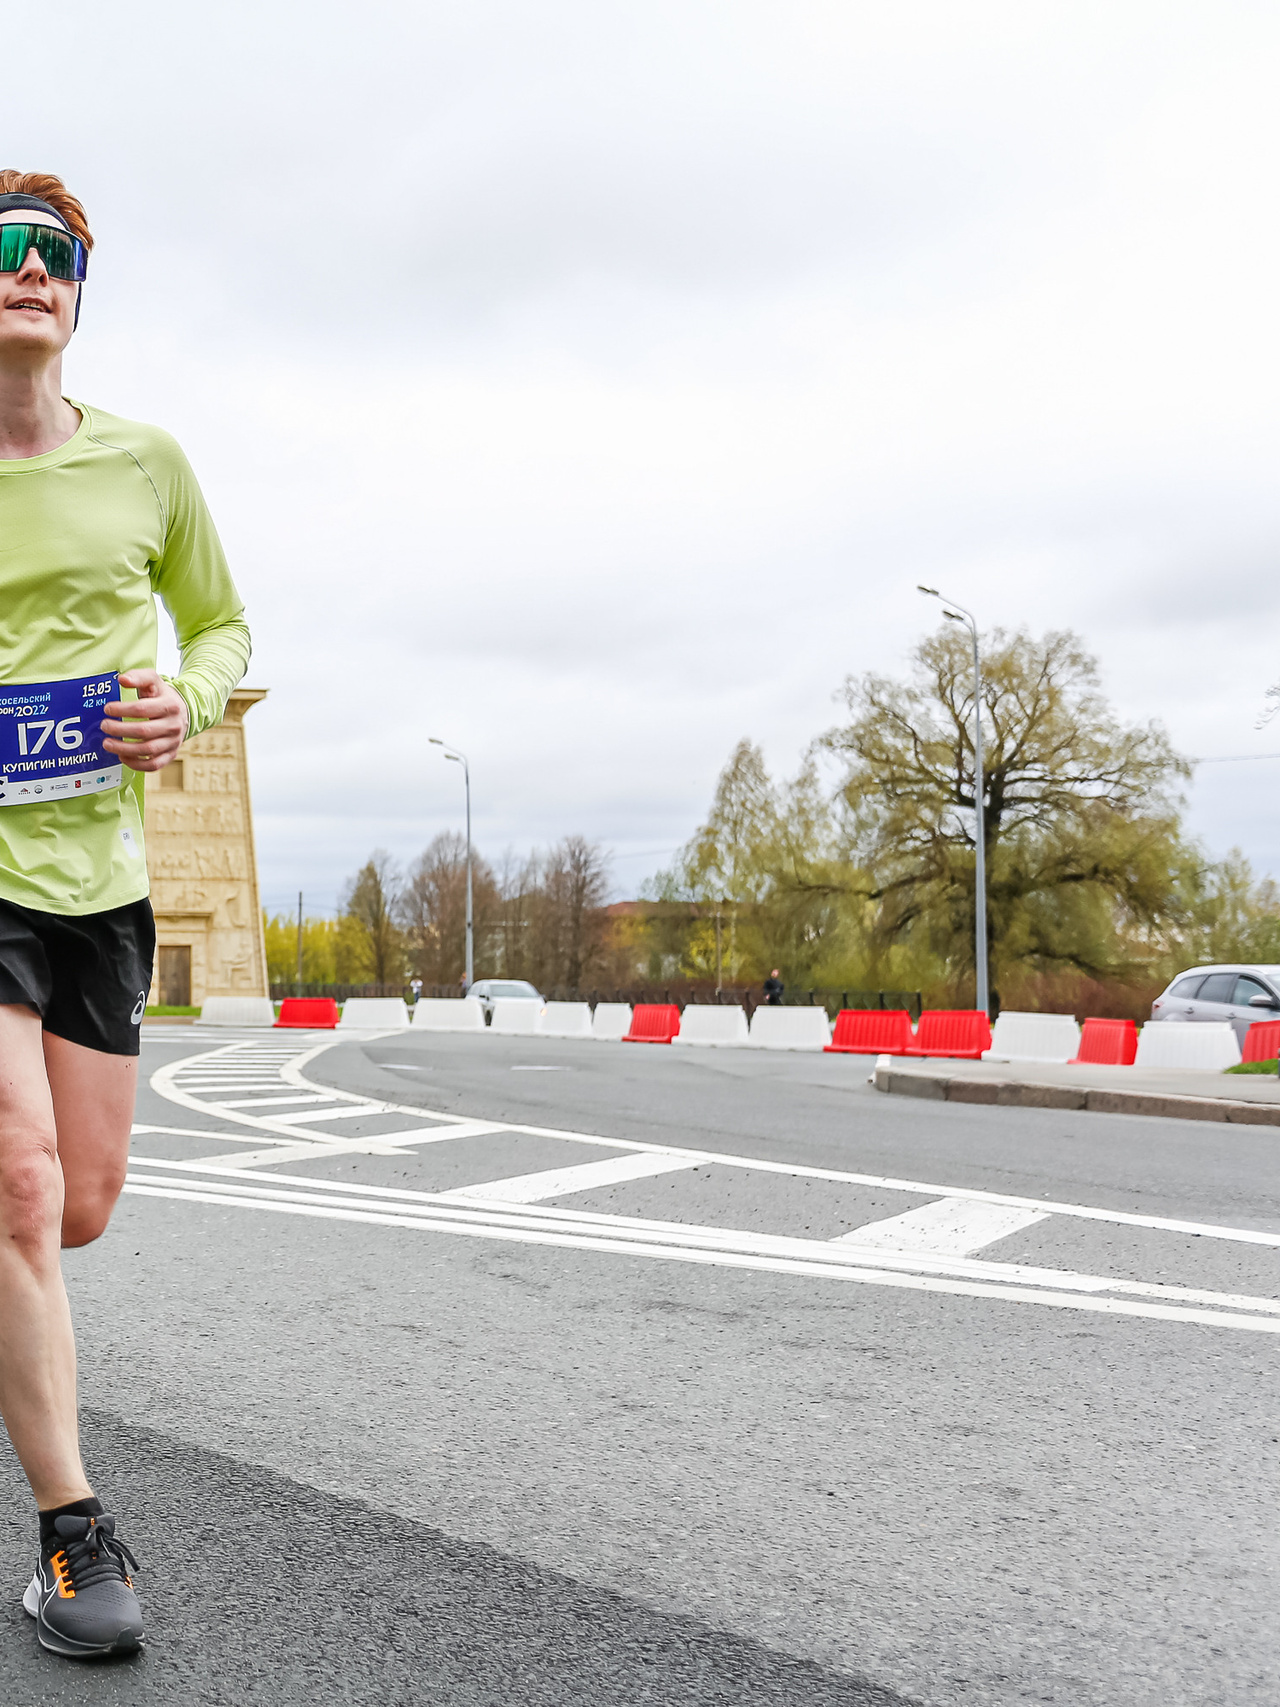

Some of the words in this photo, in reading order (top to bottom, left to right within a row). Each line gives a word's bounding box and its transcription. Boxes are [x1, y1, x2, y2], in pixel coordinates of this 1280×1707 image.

[82, 680, 112, 698] 15.05
[83, 699, 94, 708] 42
[17, 716, 83, 756] 176
[2, 758, 56, 773] КУПИГИН
[58, 752, 98, 767] НИКИТА
